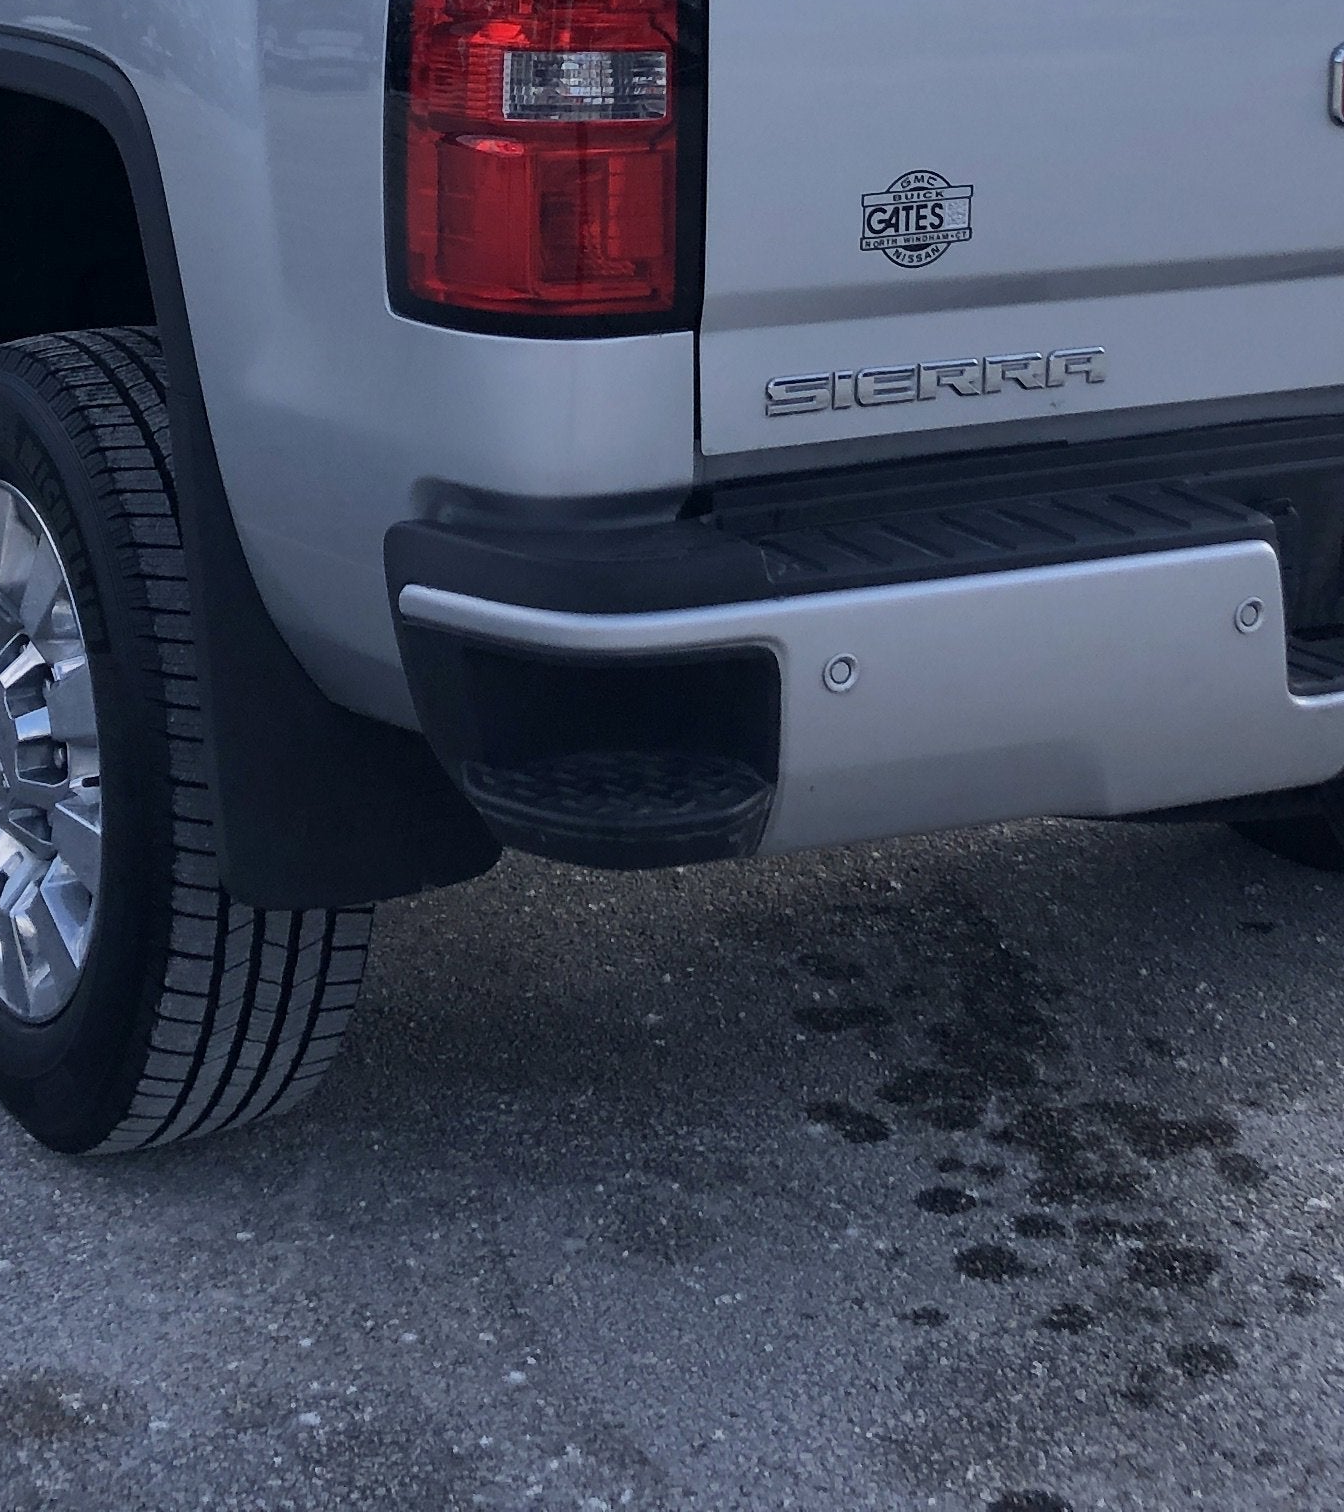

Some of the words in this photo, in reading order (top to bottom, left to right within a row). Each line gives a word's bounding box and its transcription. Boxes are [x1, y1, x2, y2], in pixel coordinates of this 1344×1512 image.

[900, 175, 937, 188] GMC
[893, 191, 944, 201] BUICK
[866, 203, 944, 234] GATES
[865, 239, 897, 248] NORTH
[893, 246, 940, 263] NISSAN
[765, 346, 1106, 417] SIERRA
